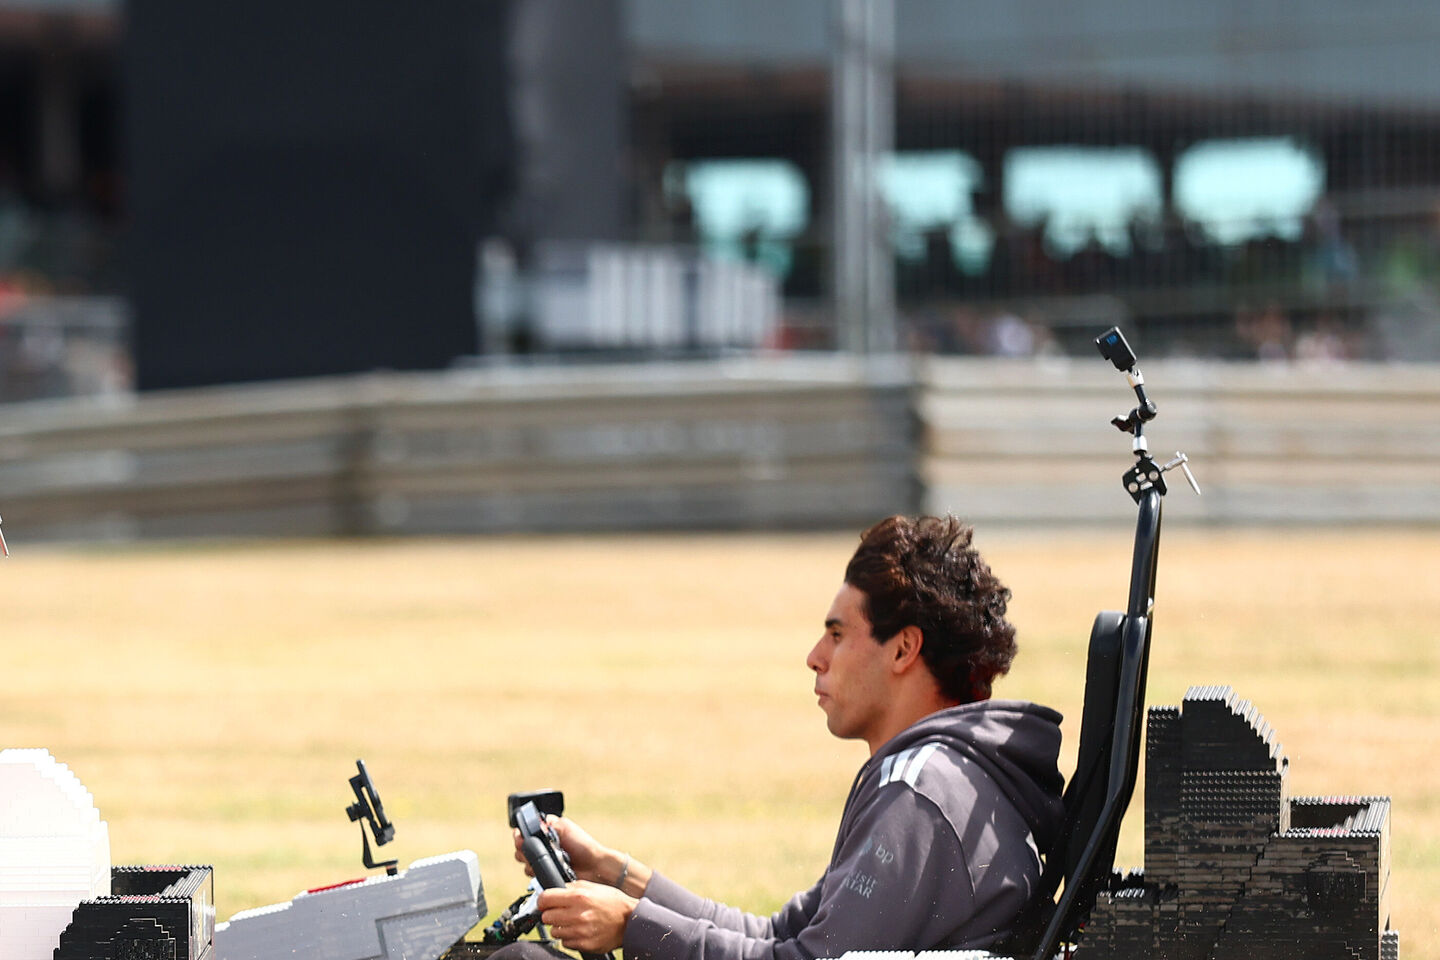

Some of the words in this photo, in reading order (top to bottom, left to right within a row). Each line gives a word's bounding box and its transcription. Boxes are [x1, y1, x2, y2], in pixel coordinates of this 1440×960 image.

[875, 844, 894, 864] bp
[846, 878, 873, 898] ATAR
[855, 870, 878, 888] isit
